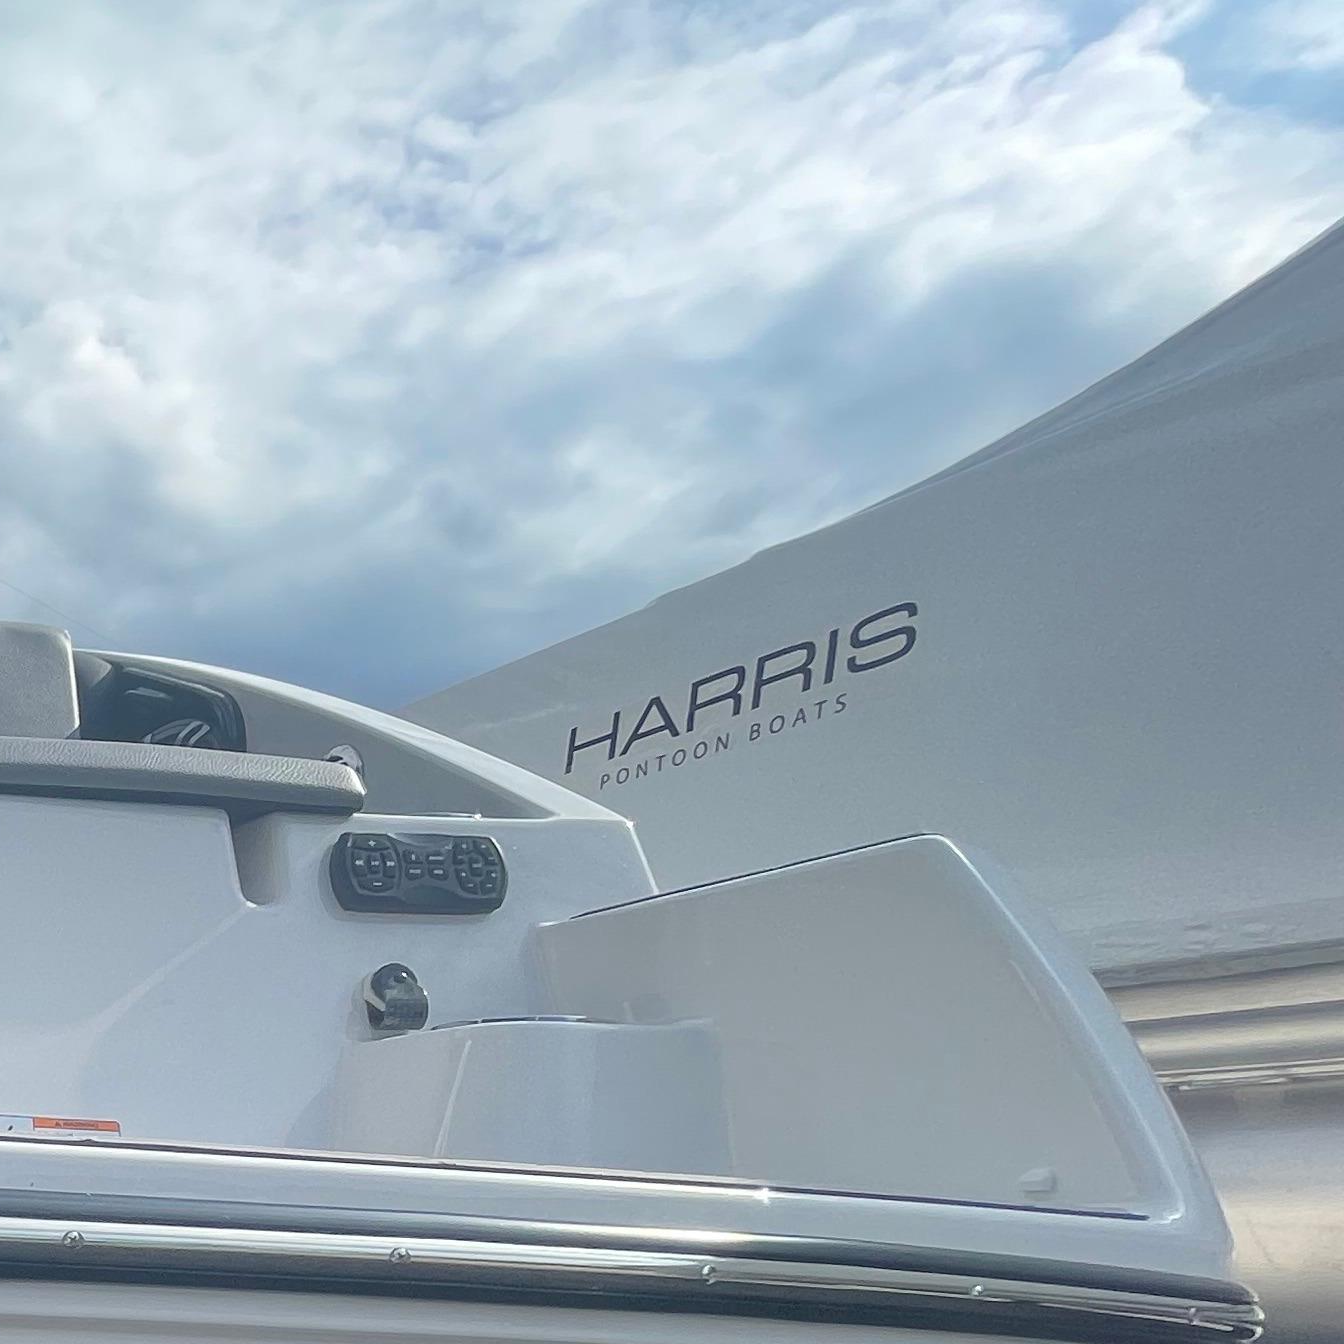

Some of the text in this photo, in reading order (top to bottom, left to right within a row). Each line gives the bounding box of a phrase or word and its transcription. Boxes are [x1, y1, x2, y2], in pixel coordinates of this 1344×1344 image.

[564, 600, 919, 775] HARRIS
[599, 693, 849, 790] PONTOON BOATS
